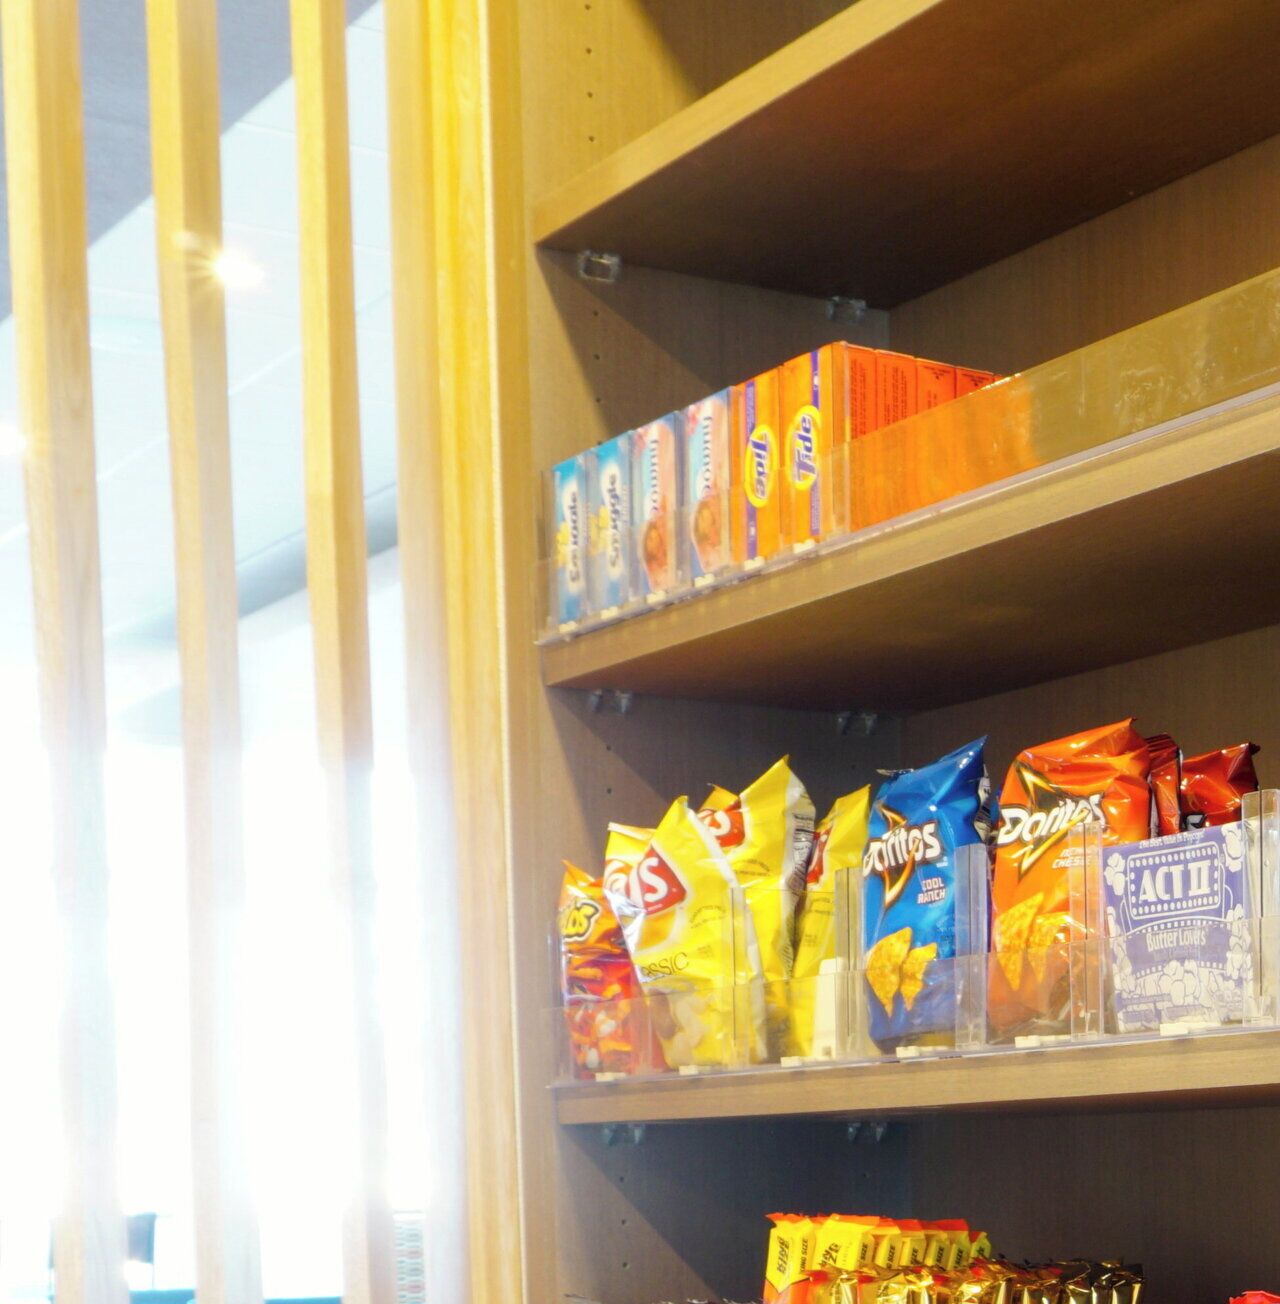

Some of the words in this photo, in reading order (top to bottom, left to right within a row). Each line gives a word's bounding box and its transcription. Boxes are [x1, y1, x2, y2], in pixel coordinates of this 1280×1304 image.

[750, 430, 769, 500] Tide
[793, 414, 815, 483] Tide
[605, 471, 621, 570] Snuggle
[997, 794, 1107, 846] Doritos
[917, 888, 947, 905] RANCH
[922, 877, 944, 891] COOL
[1138, 865, 1185, 904] ACT
[1146, 930, 1177, 952] Butter
